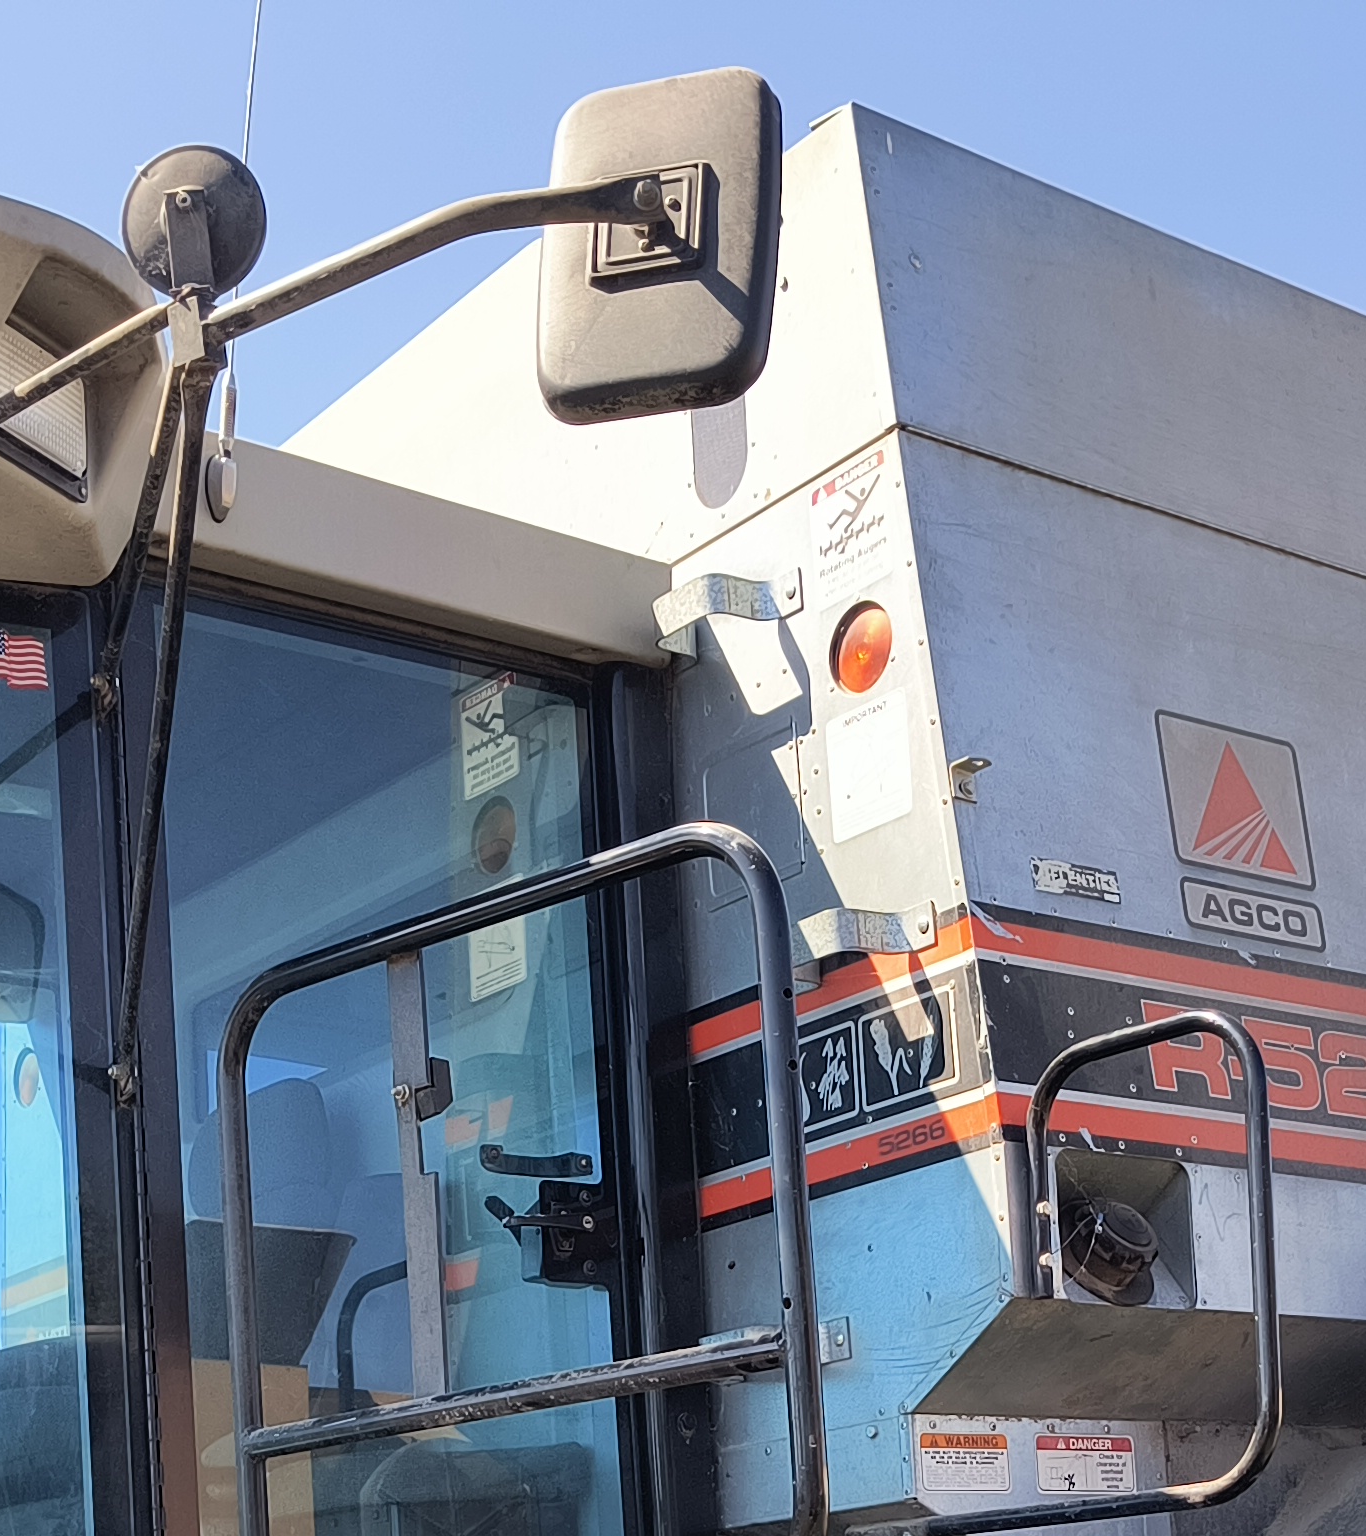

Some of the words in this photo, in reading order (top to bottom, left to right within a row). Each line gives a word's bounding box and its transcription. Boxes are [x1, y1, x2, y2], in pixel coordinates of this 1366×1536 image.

[842, 700, 888, 728] IMPORTANT
[1201, 893, 1308, 938] AGCO
[878, 1118, 946, 1156] 5266
[944, 1435, 999, 1447] WARNING
[1069, 1438, 1113, 1450] DANGER
